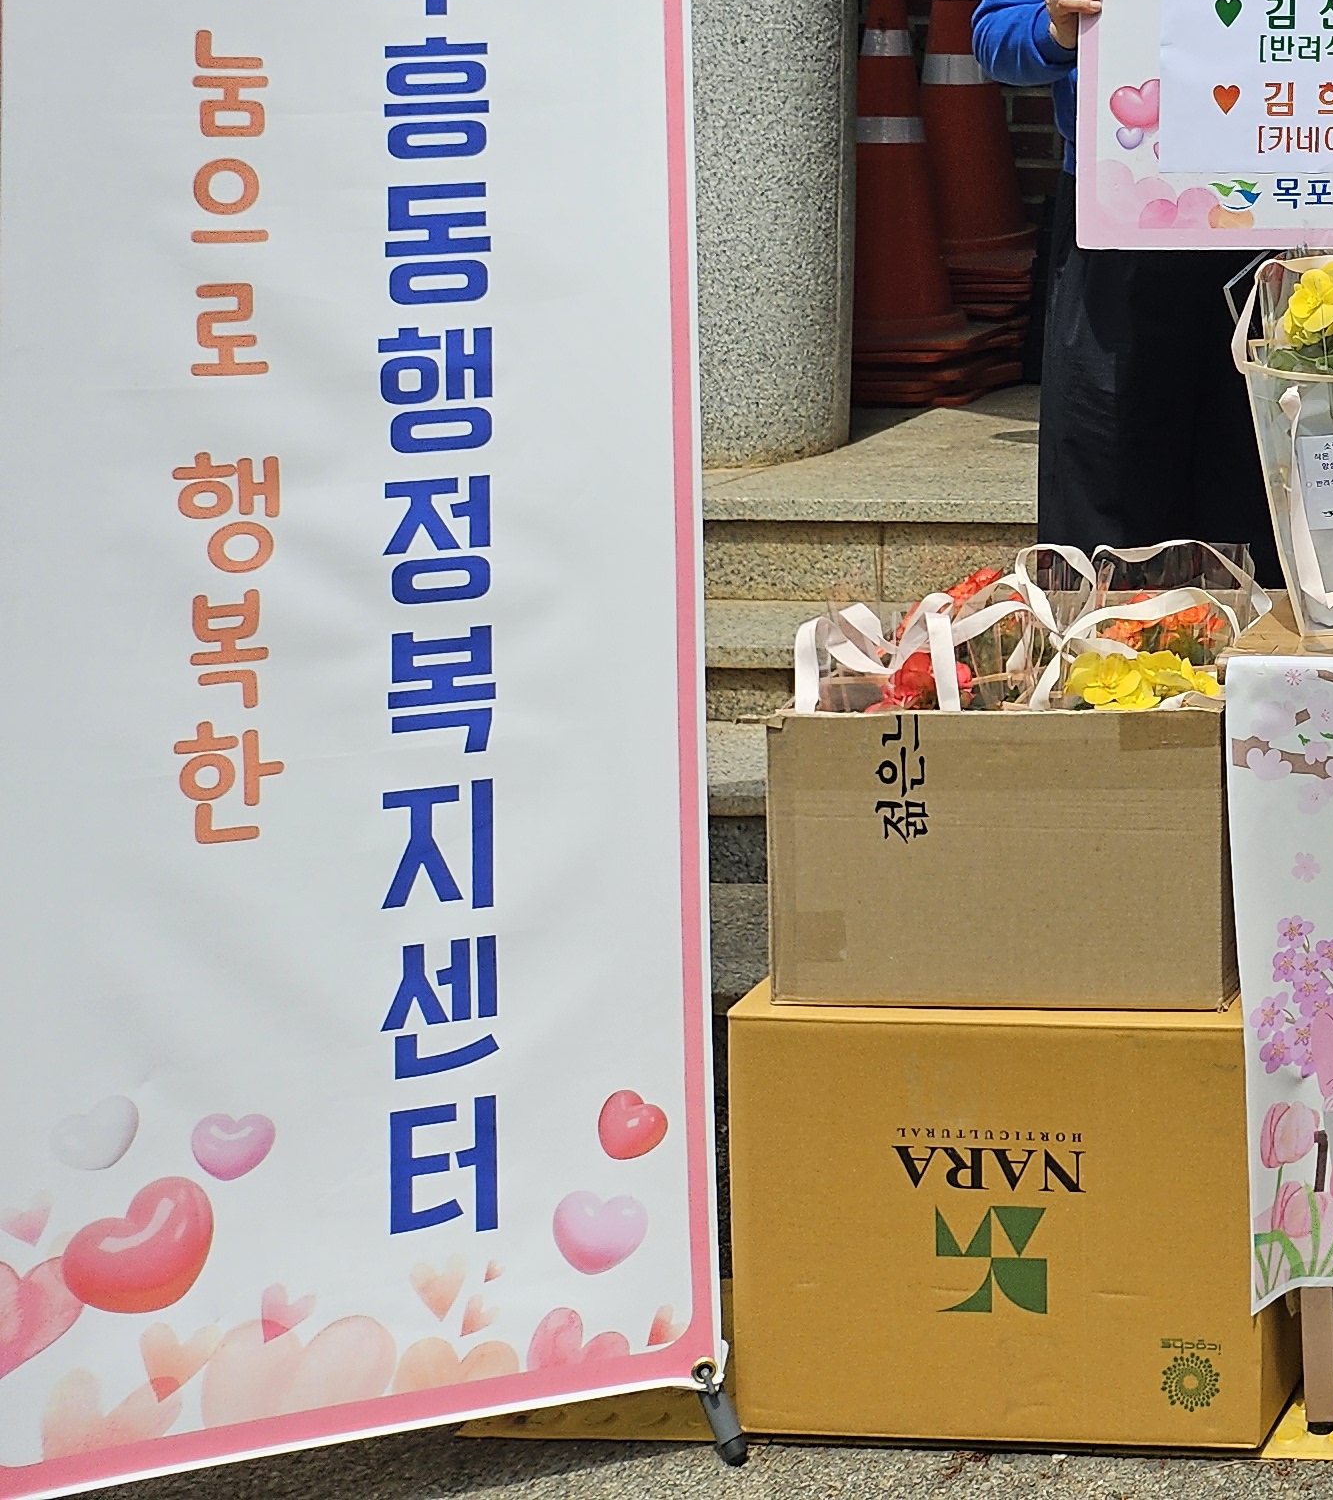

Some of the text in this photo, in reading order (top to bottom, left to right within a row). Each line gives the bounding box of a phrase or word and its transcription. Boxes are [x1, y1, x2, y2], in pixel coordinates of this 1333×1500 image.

[1264, 82, 1295, 117] 김
[171, 451, 285, 845] 행복한
[875, 714, 929, 845] 젊은느
[895, 1127, 1082, 1143] HORTICULTURAL
[891, 1145, 1087, 1194] NARA
